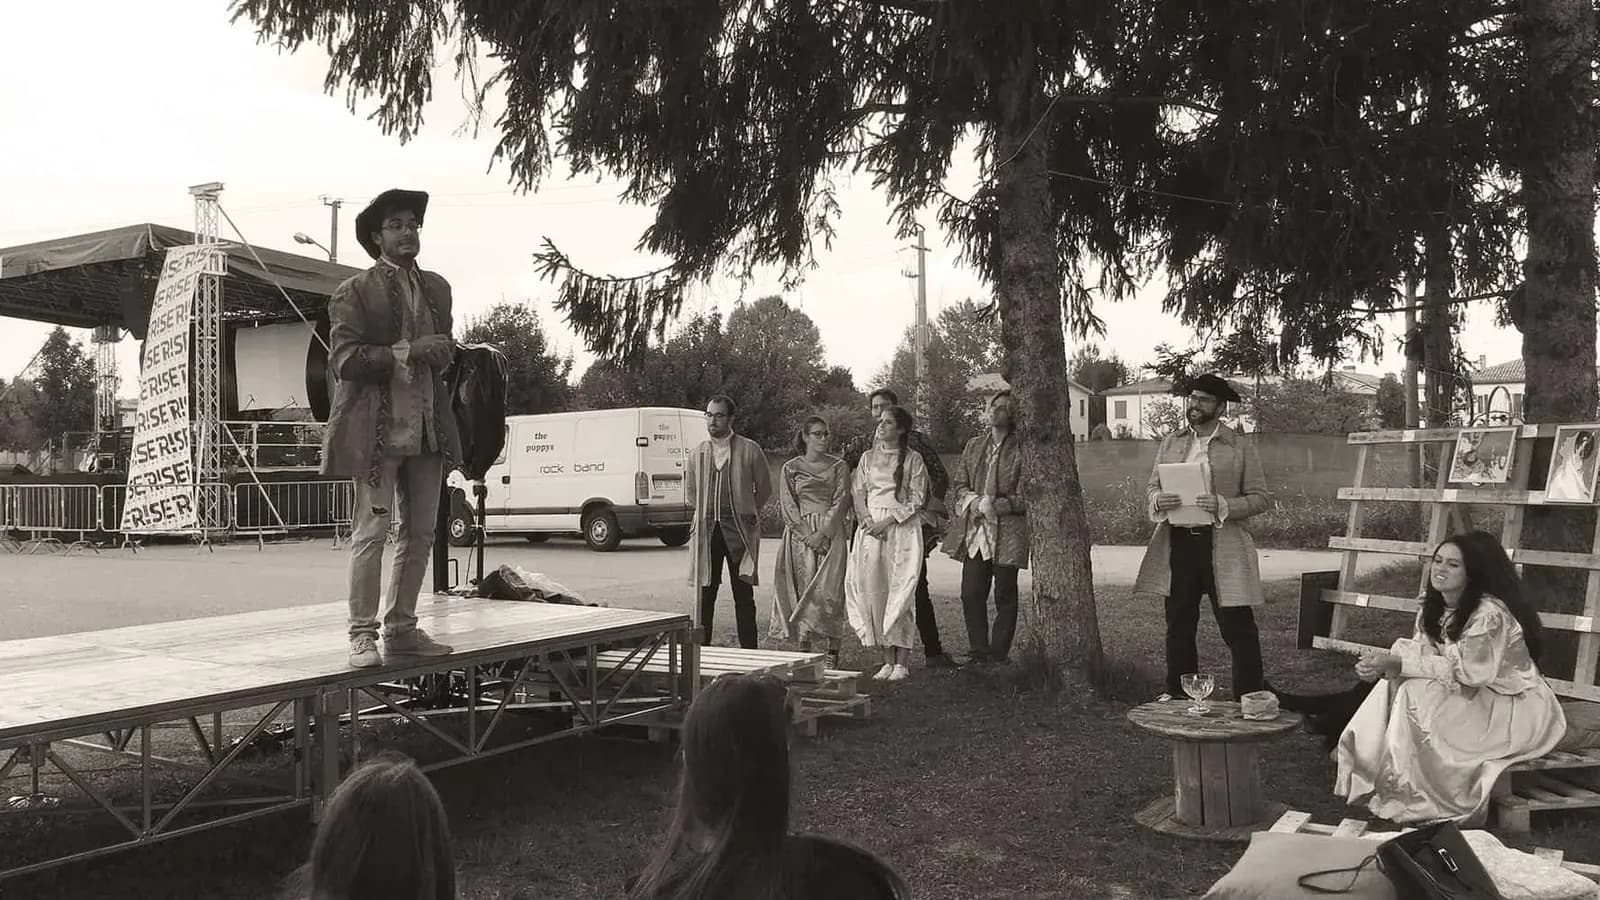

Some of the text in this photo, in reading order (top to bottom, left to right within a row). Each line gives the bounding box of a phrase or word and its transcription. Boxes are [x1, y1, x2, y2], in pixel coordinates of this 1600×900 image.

[534, 432, 548, 440] the
[526, 444, 554, 453] puppys
[540, 461, 605, 474] rock band
